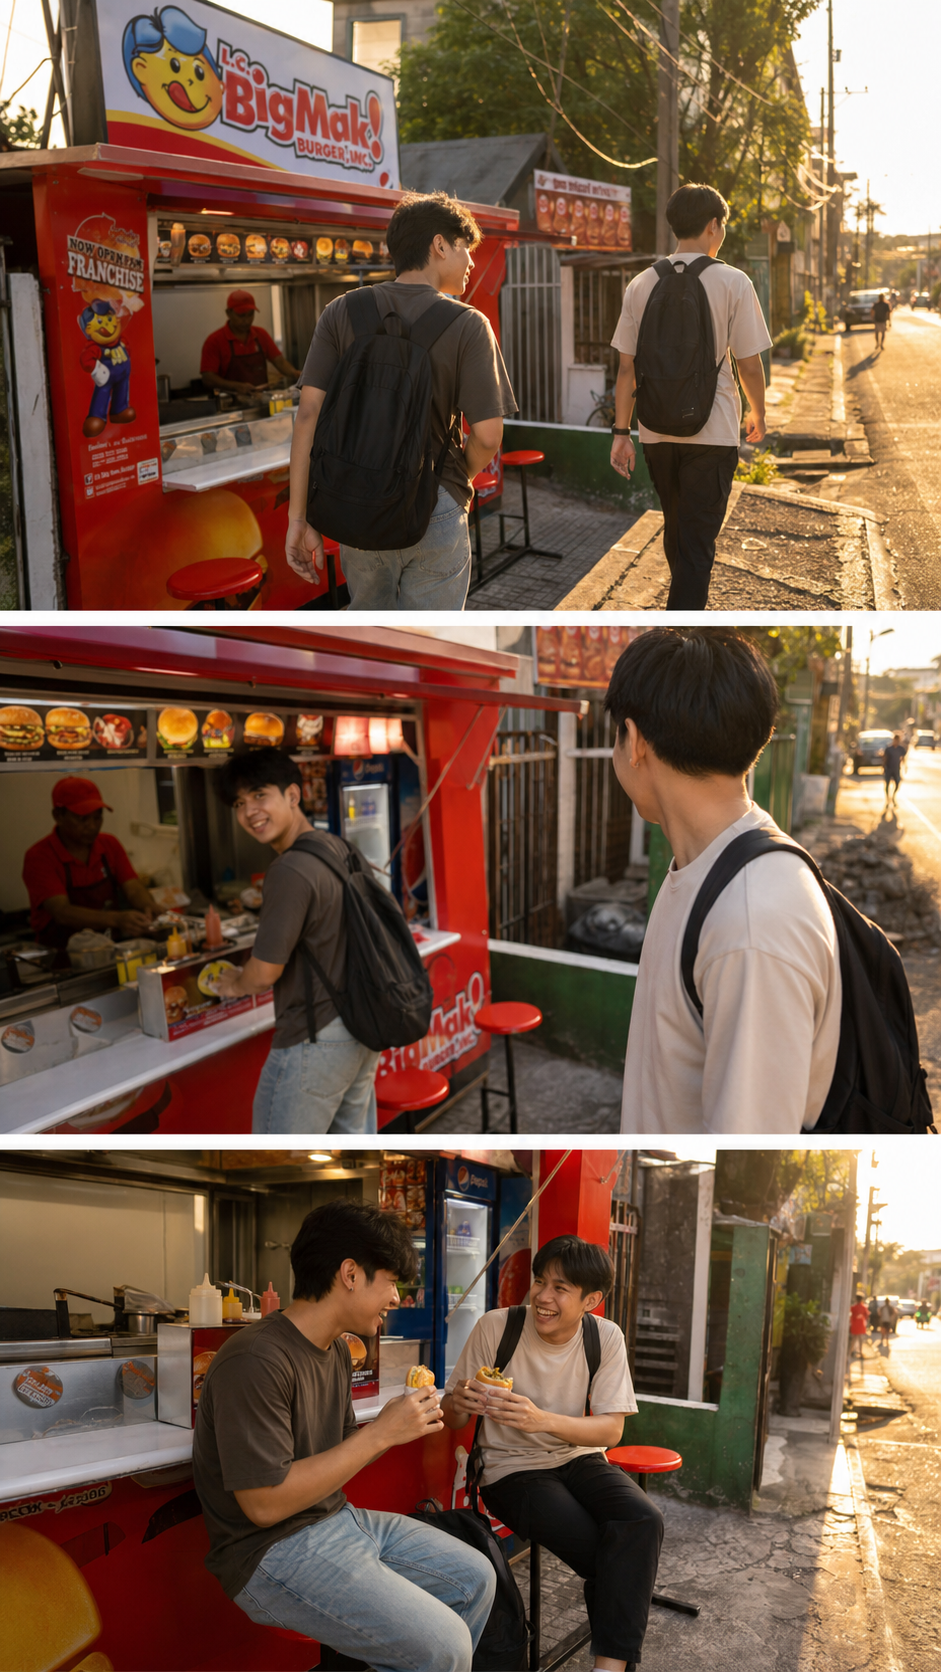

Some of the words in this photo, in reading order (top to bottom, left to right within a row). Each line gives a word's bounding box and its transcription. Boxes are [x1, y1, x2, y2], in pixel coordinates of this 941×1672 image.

[221, 46, 252, 77] L.C.
[224, 66, 384, 161] BigMak!
[69, 237, 94, 257] NOW
[67, 251, 145, 293] FRANCHISE
